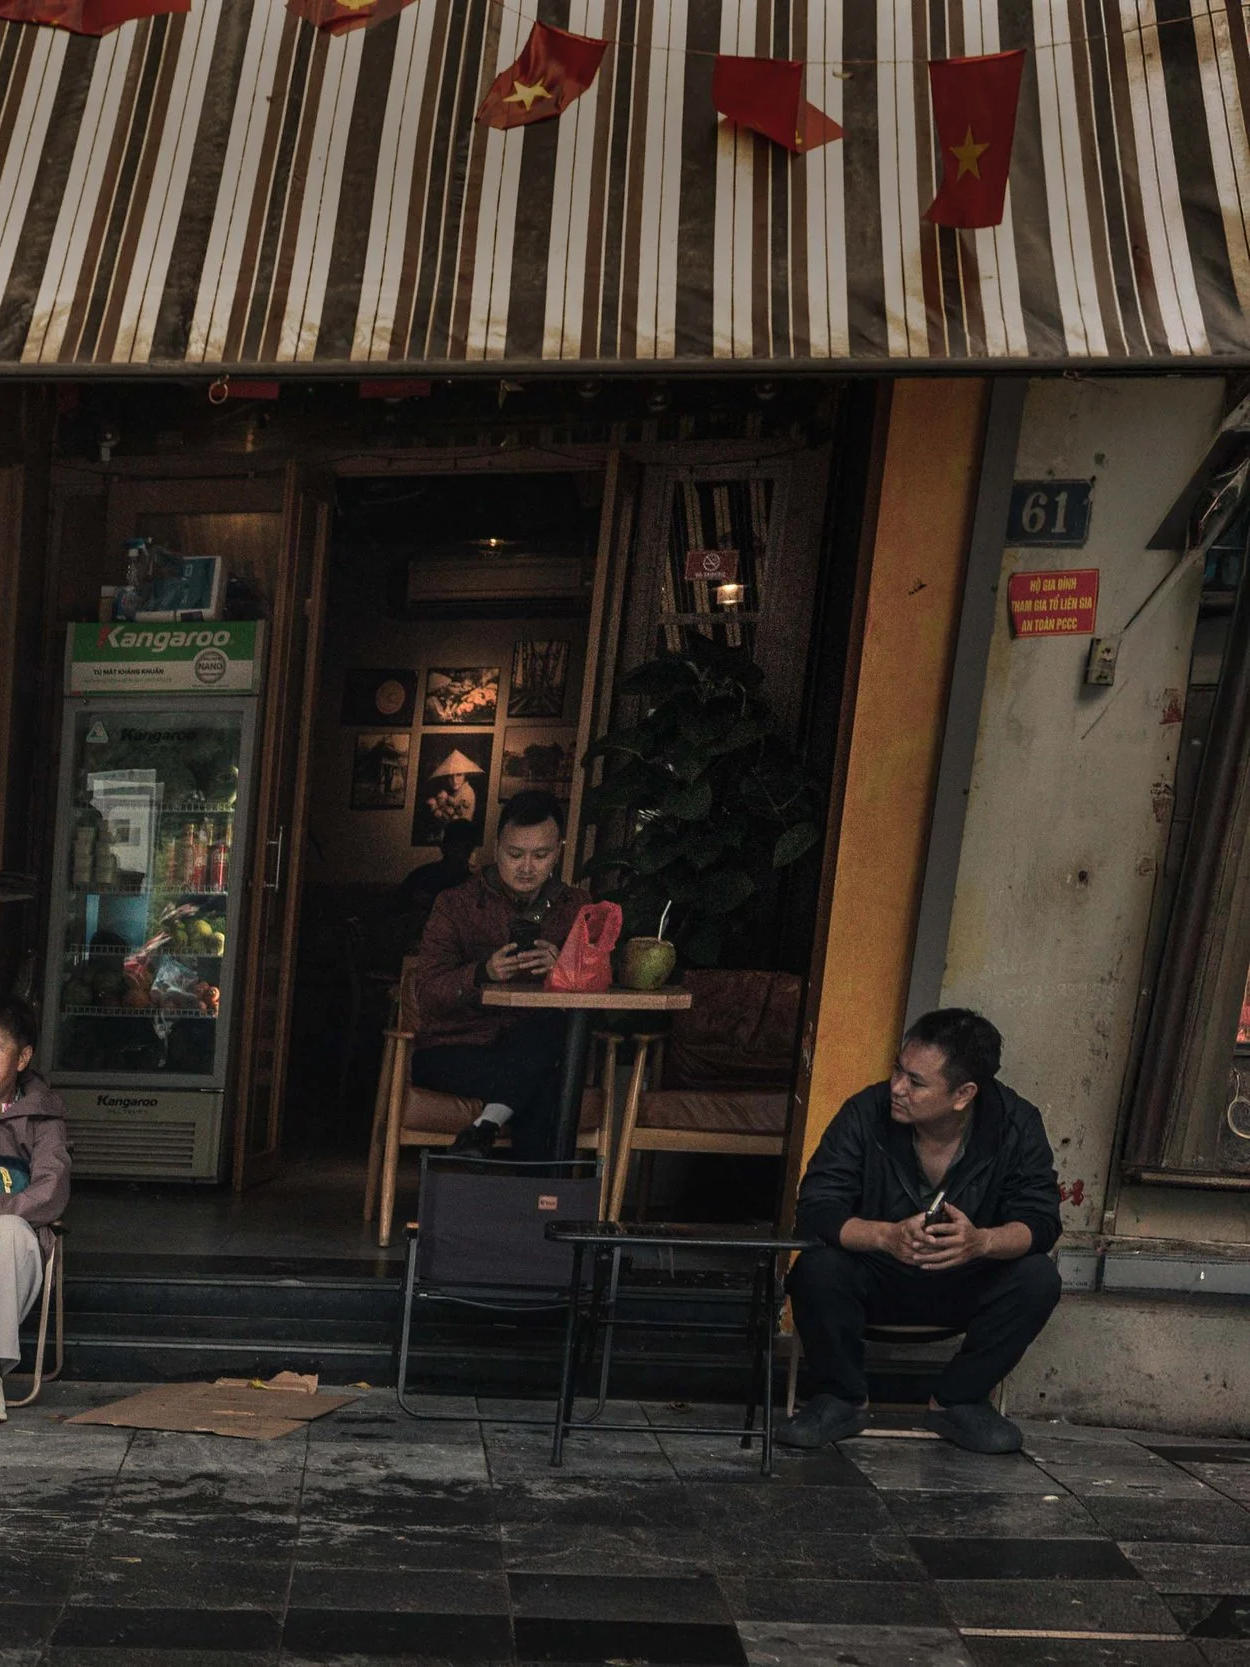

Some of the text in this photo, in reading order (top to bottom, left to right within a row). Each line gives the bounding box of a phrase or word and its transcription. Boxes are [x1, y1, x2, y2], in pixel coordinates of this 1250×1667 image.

[1021, 492, 1068, 533] 61
[1056, 617, 1078, 630] PCCC
[97, 625, 230, 653] Kangaroo
[97, 1095, 158, 1108] Kangaroo
